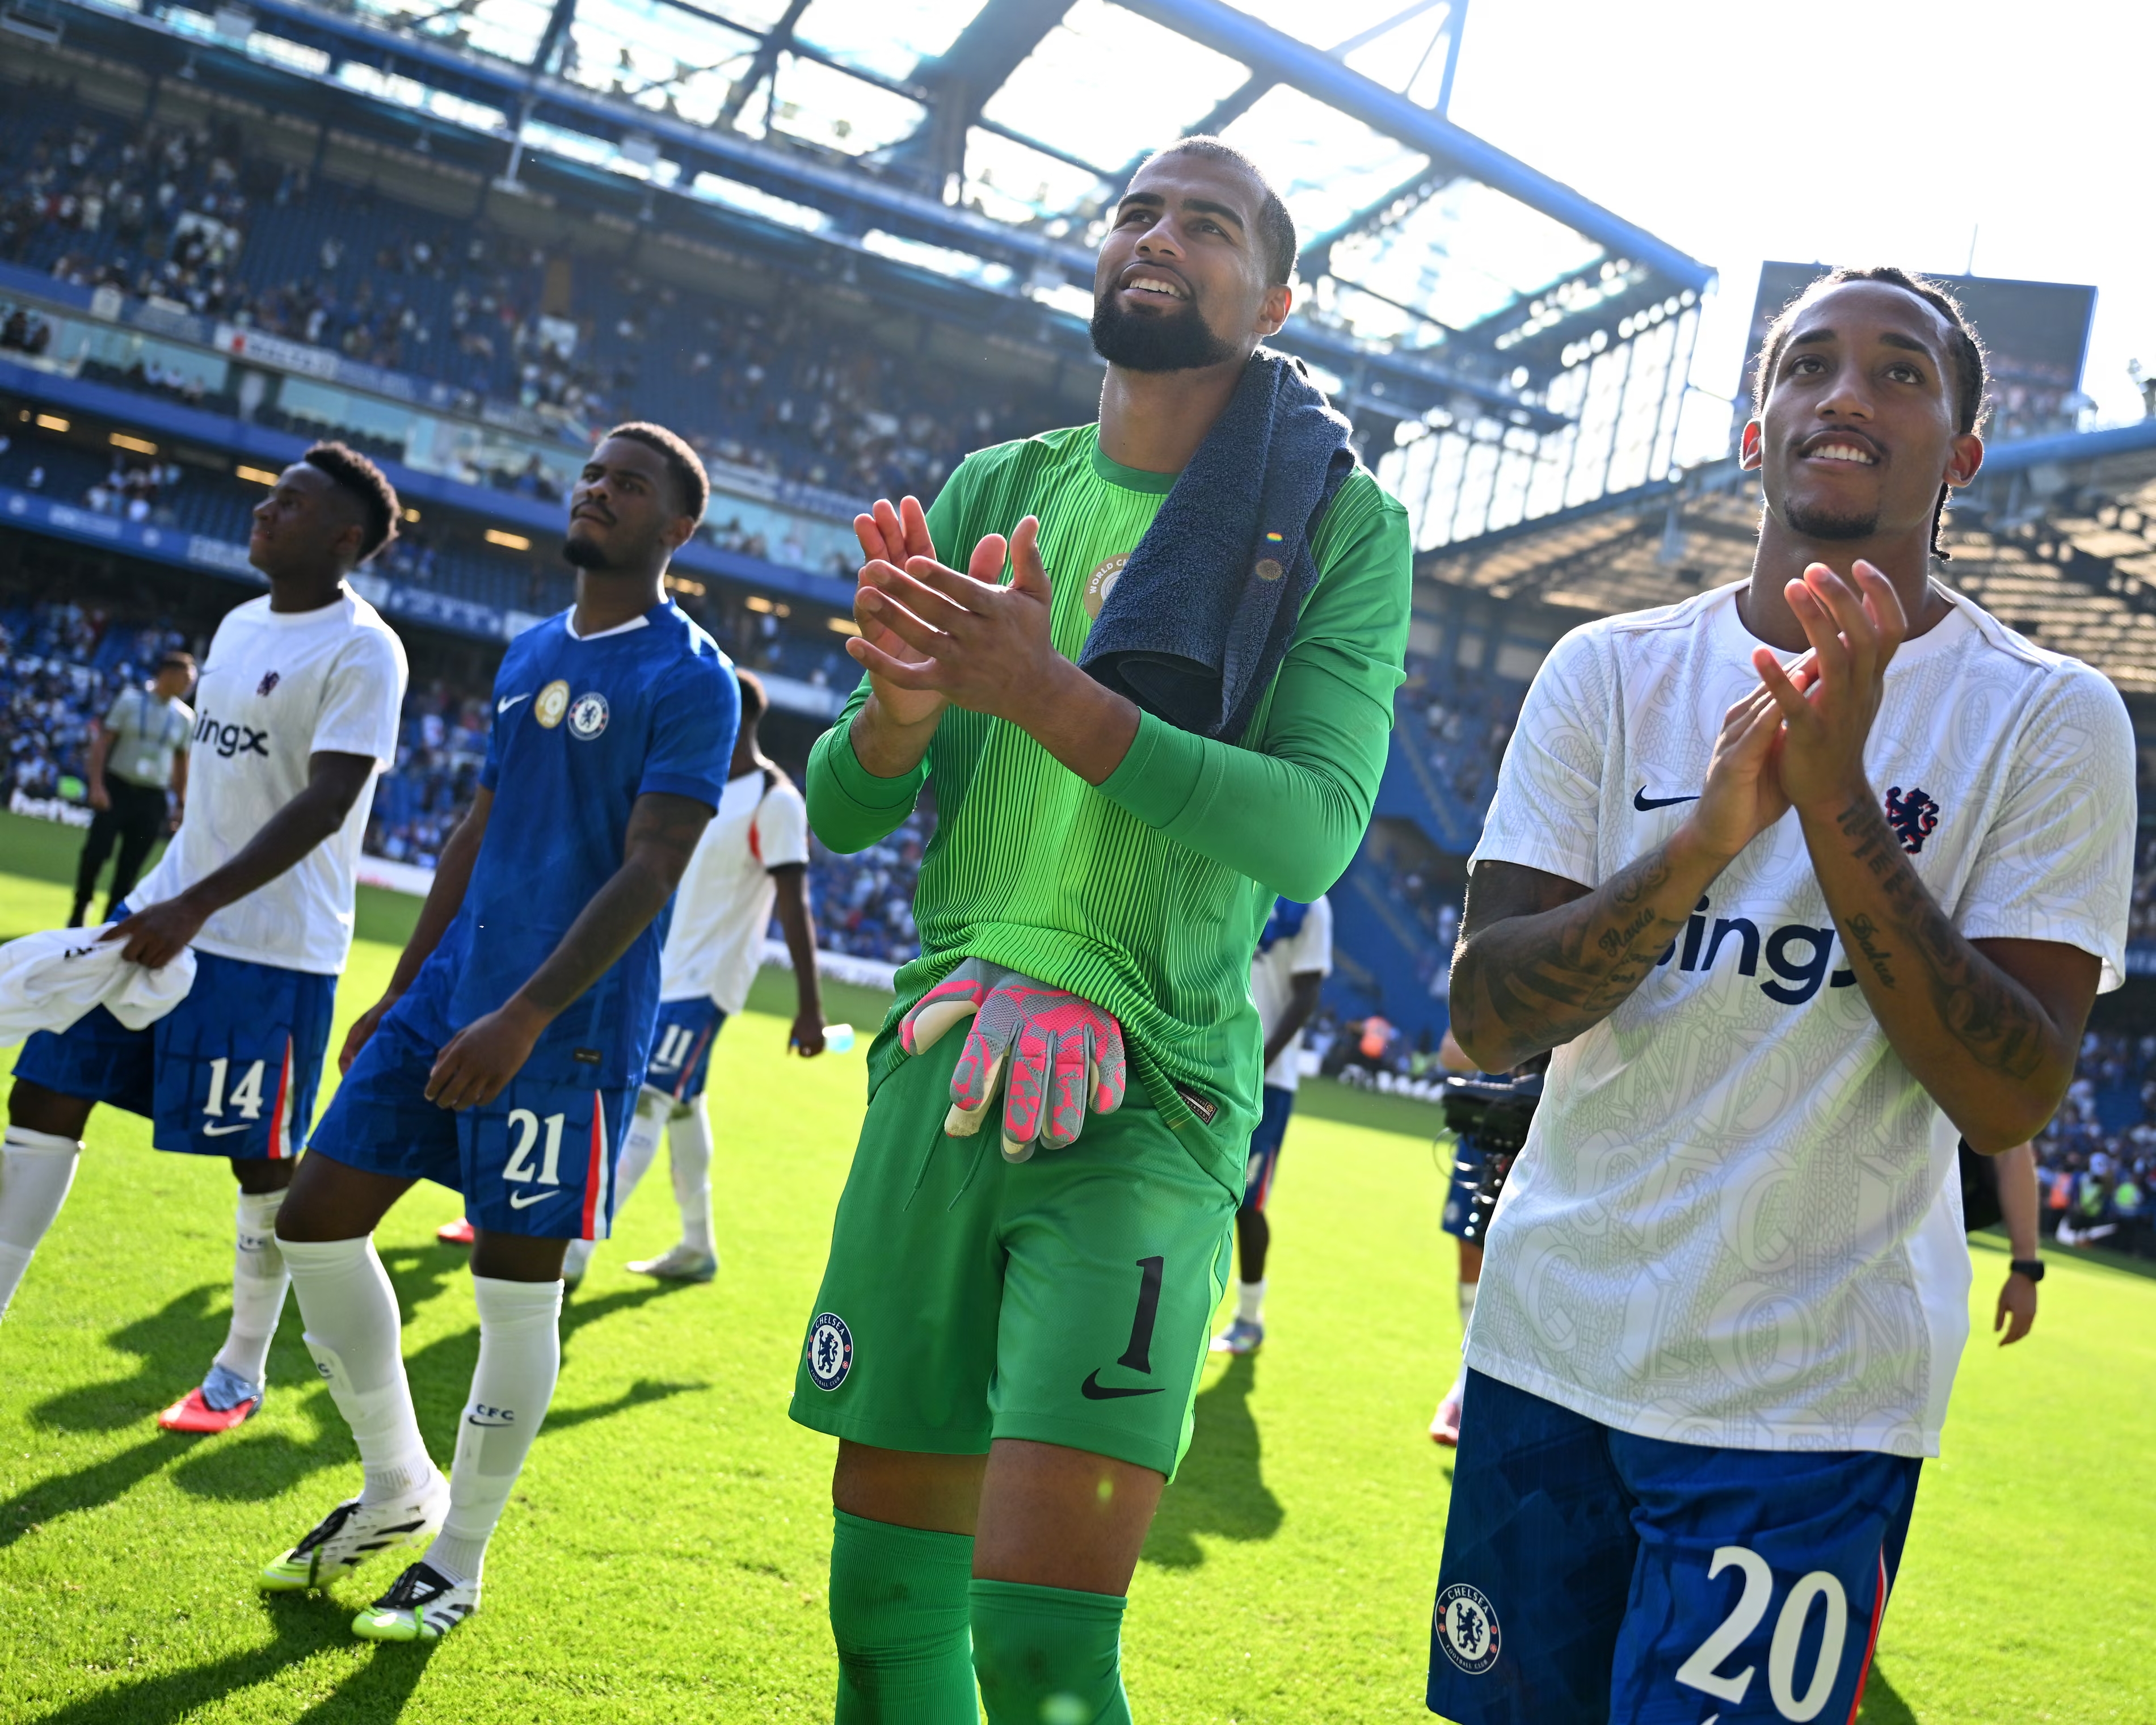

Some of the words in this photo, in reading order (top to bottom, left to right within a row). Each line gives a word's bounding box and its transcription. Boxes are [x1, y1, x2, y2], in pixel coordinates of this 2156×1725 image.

[1089, 562, 1114, 594] WORLD
[192, 708, 269, 758] ingx
[1657, 894, 1857, 1004] ing
[655, 1024, 693, 1068] 11
[203, 1057, 265, 1119] 14
[502, 1108, 565, 1185] 21
[815, 1315, 845, 1336] CHELSEA
[1117, 1256, 1164, 1375] 1
[810, 1369, 829, 1387] FOOTBALL
[829, 1376, 840, 1387] CLUB
[477, 1403, 514, 1421] CFC
[1447, 1587, 1489, 1614] CHELSEA
[1446, 1644, 1472, 1669] FOOTBALL
[1474, 1659, 1489, 1669] CLUB
[1675, 1546, 1847, 1723] 20
